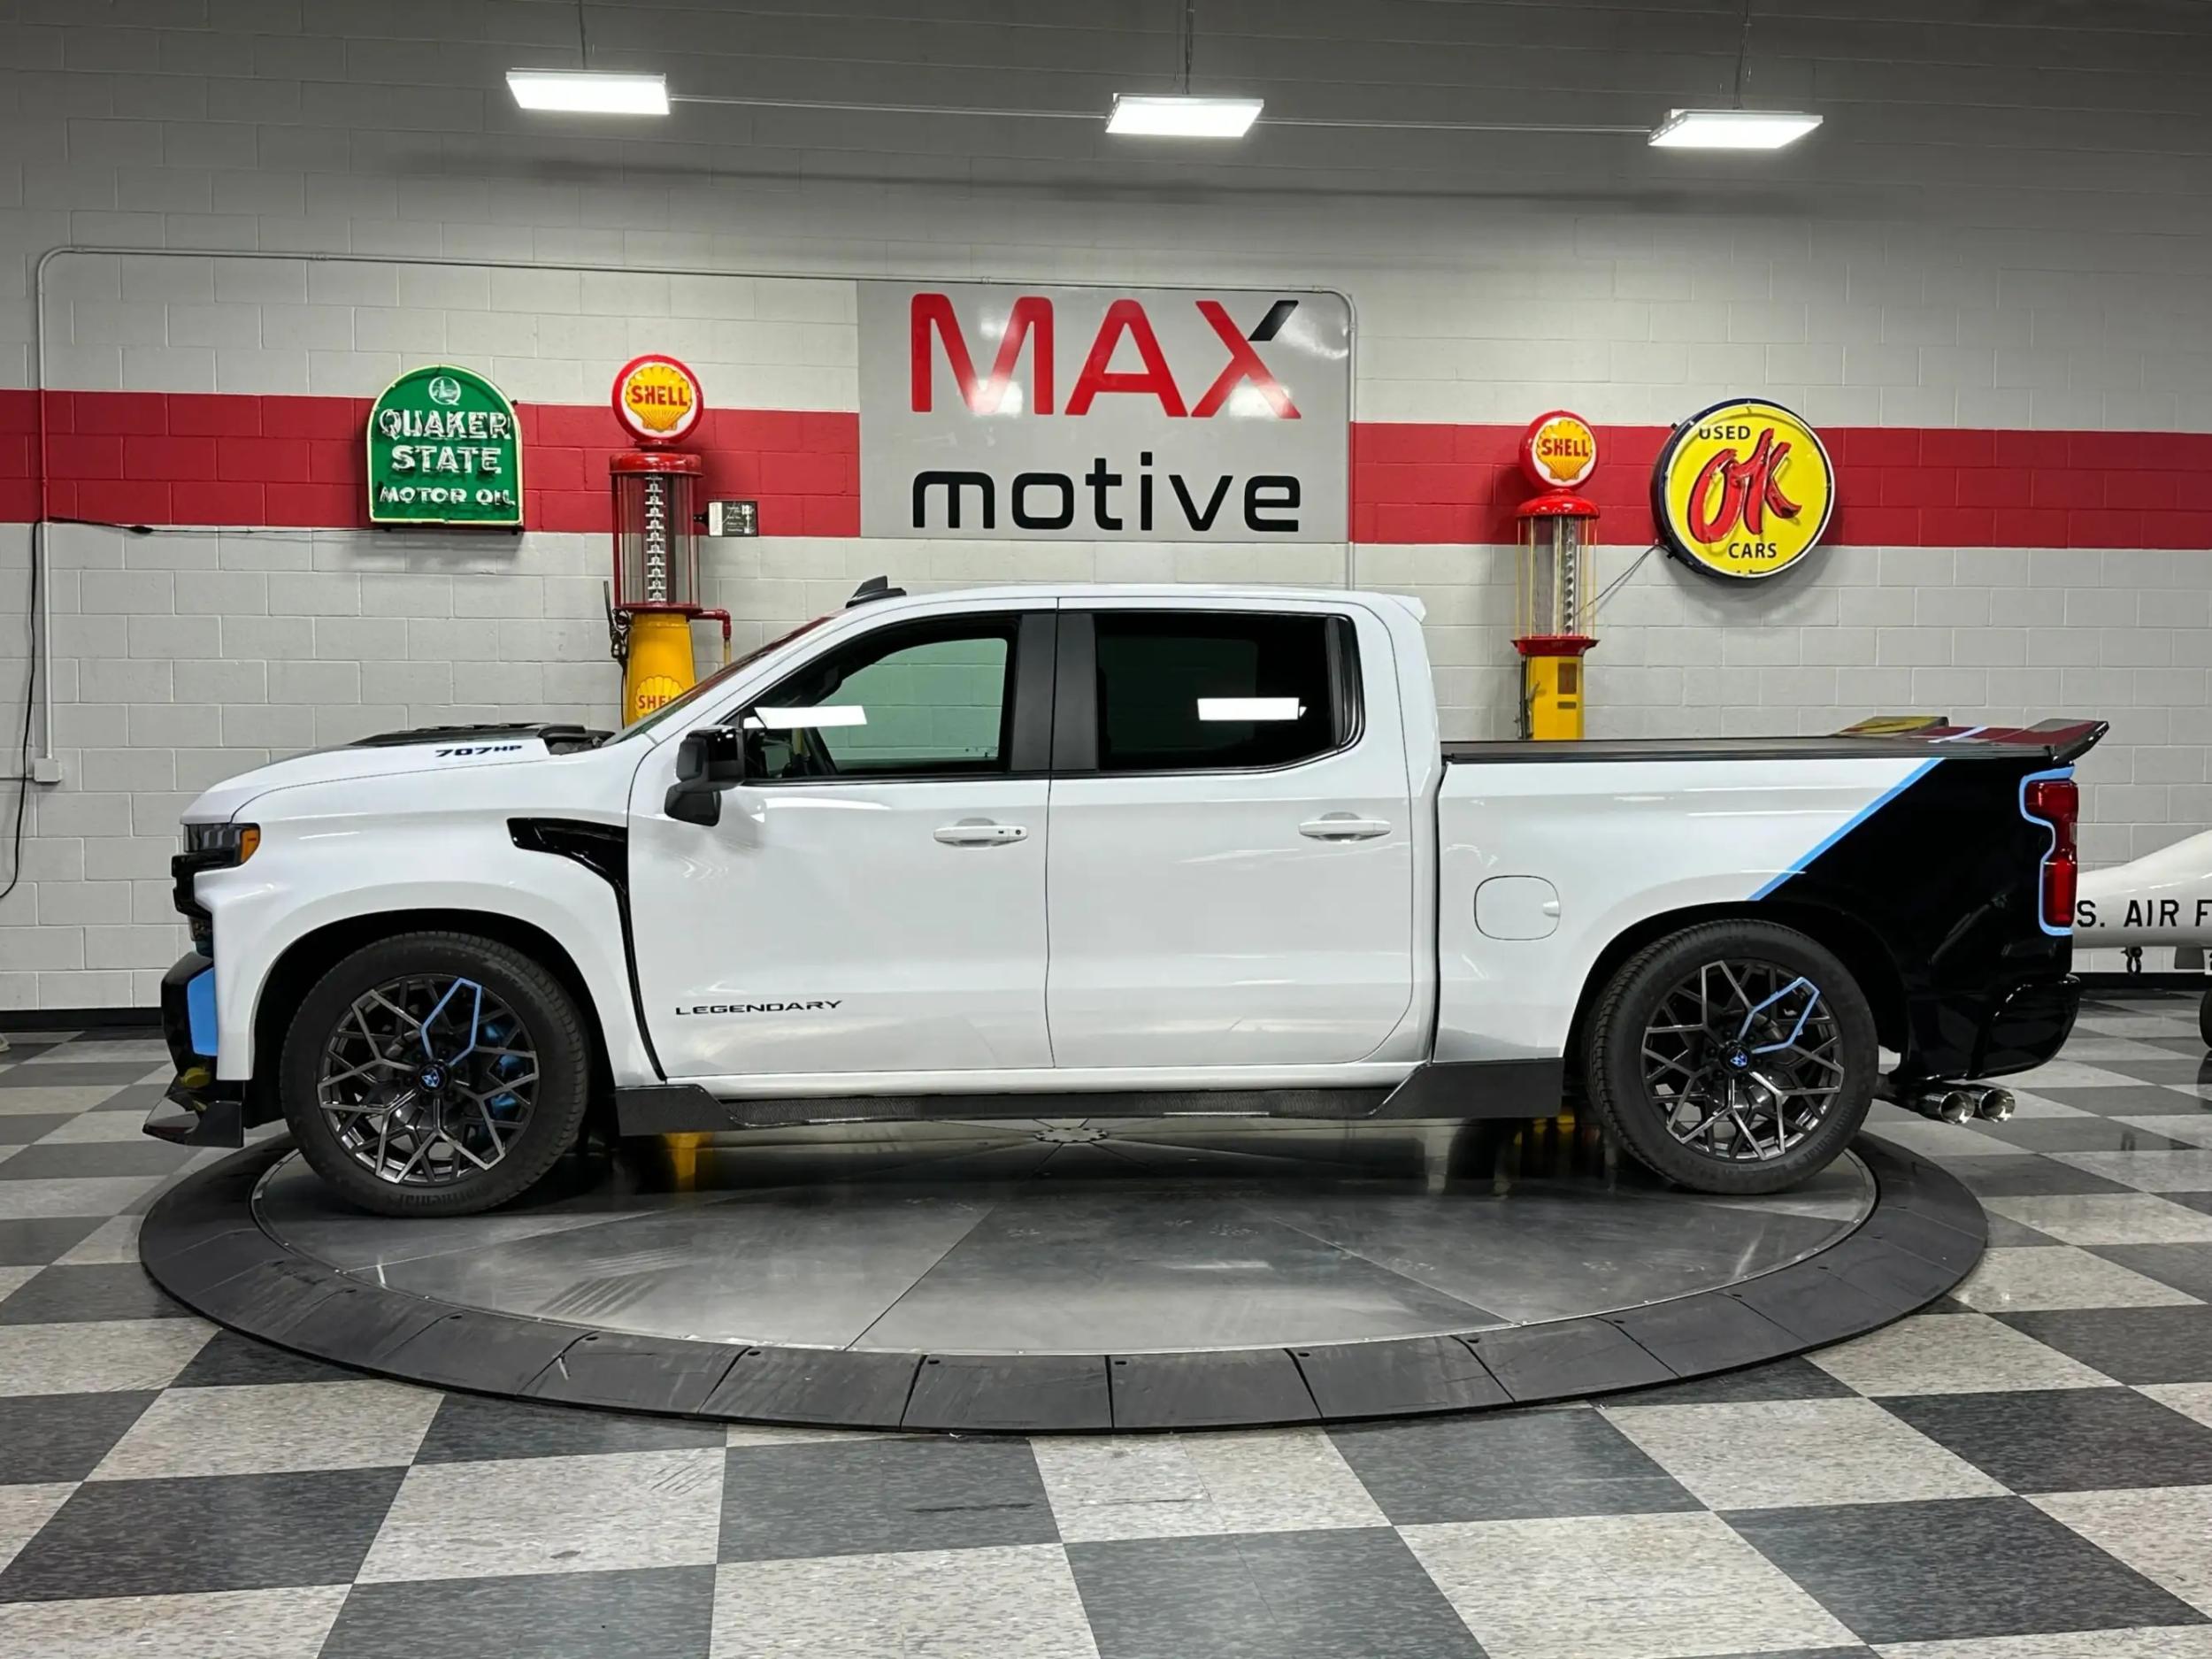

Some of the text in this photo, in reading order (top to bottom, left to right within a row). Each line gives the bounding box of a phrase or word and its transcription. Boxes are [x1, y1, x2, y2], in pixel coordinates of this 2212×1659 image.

[910, 293, 1302, 419] MAX
[630, 385, 688, 407] SHELL
[379, 408, 511, 441] QUAKER
[1698, 425, 1751, 441] USED
[1540, 438, 1589, 457] SHELL
[391, 444, 503, 474] STATE
[379, 486, 516, 506] MOTOR OIL
[912, 451, 1302, 533] motive
[1686, 427, 1802, 544] OK
[1728, 542, 1778, 558] CARS
[638, 695, 672, 709] SHE
[434, 745, 523, 758] 707HP
[2077, 899, 2212, 927] S. AIR F
[675, 1000, 842, 1016] LEGENDARY
